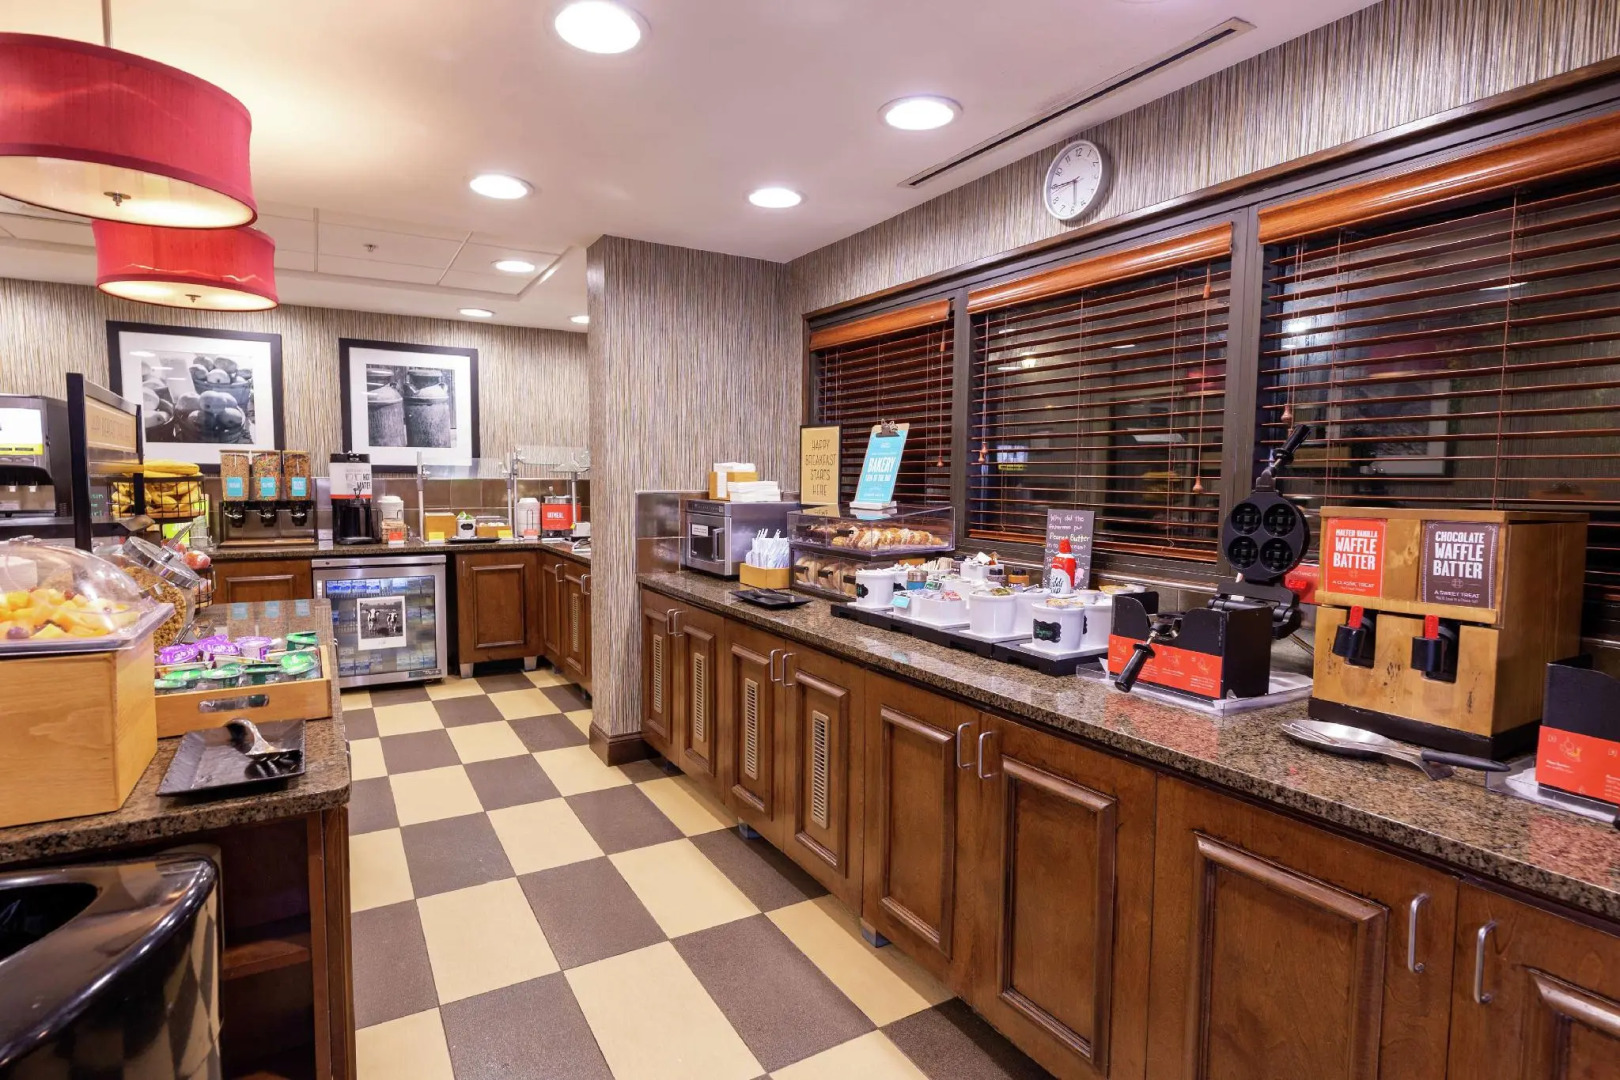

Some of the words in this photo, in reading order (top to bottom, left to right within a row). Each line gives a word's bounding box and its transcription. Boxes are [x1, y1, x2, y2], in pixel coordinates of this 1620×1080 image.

[1076, 148, 1082, 157] 12
[1065, 155, 1070, 163] 11
[1055, 168, 1062, 176] 10
[1052, 196, 1059, 205] 8
[1059, 204, 1066, 212] 7
[811, 439, 830, 451] HAPPY
[805, 454, 836, 466] BREAKFAST
[868, 457, 896, 472] BAKERY
[810, 469, 831, 481] STARTS
[812, 484, 828, 496] HERE
[1069, 533, 1090, 543] Butter
[1434, 531, 1486, 544] CHOCOLATE
[1335, 537, 1378, 555] WAFFLE
[1434, 542, 1485, 562] WAFFLE
[1333, 552, 1375, 570] BATTER
[1433, 560, 1482, 579] BATTER
